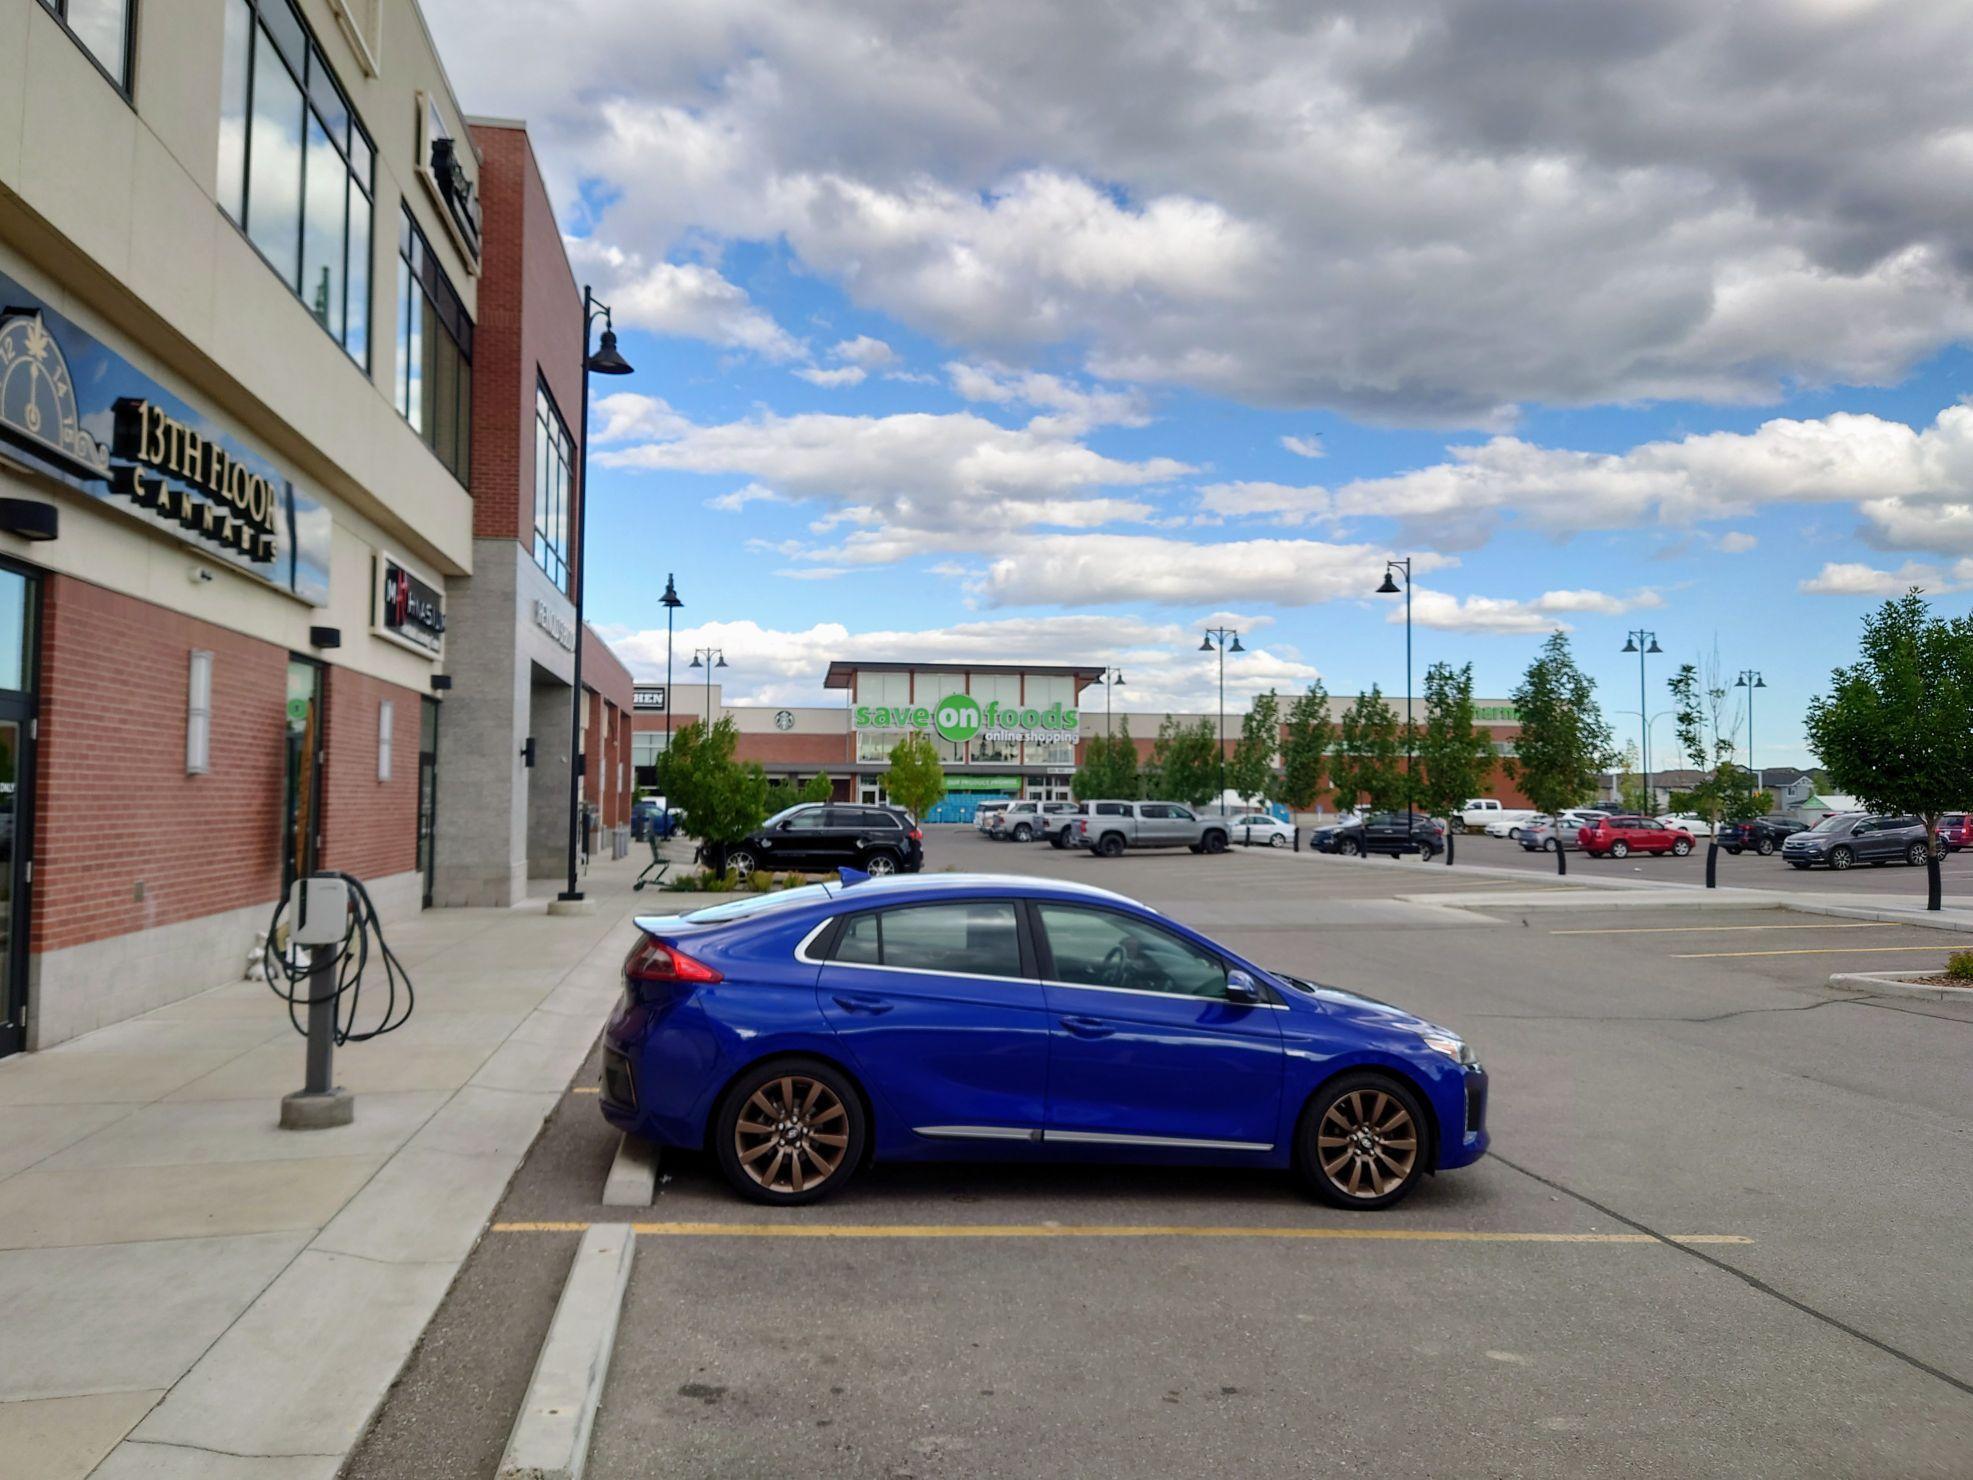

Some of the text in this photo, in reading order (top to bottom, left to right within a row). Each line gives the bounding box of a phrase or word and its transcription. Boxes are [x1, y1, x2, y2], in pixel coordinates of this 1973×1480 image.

[137, 400, 277, 531] 13TH FLOOR
[133, 467, 277, 563] CANNABIS
[855, 701, 1079, 730] save on foods
[985, 731, 1079, 745] online shopping
